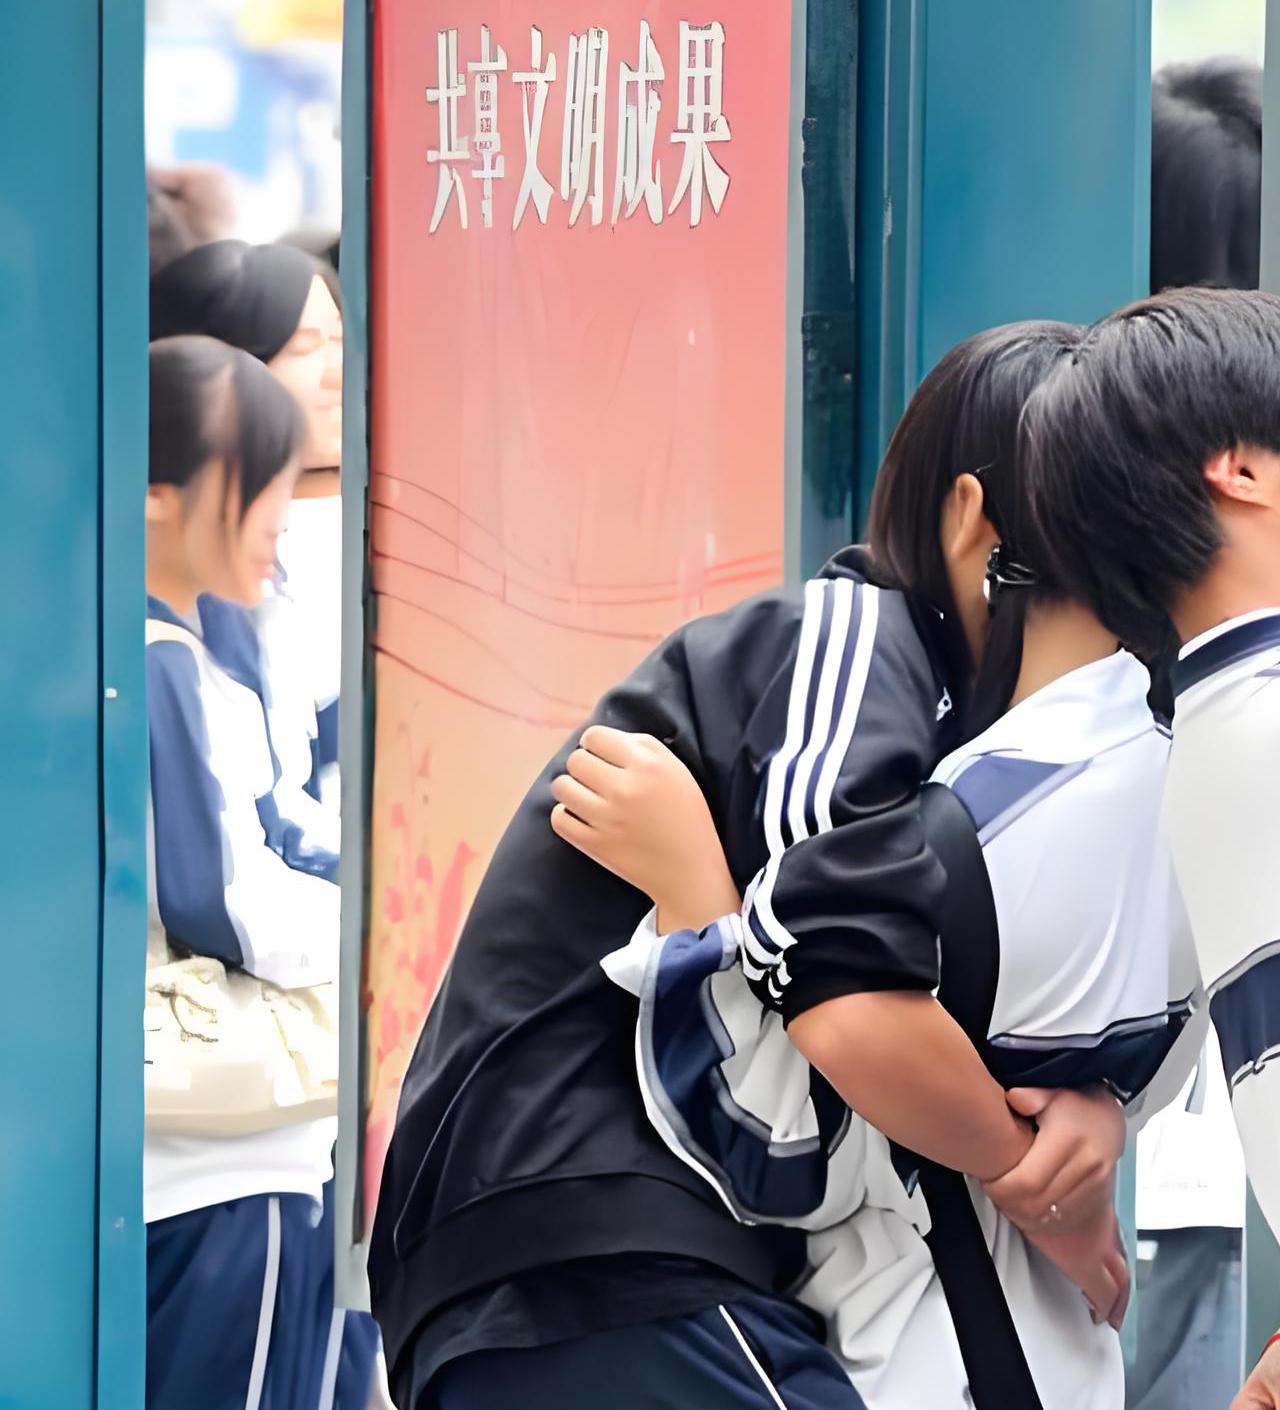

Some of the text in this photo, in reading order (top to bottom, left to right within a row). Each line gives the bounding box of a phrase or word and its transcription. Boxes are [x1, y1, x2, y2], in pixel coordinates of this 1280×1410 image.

[426, 19, 731, 234] 共享文明成果
